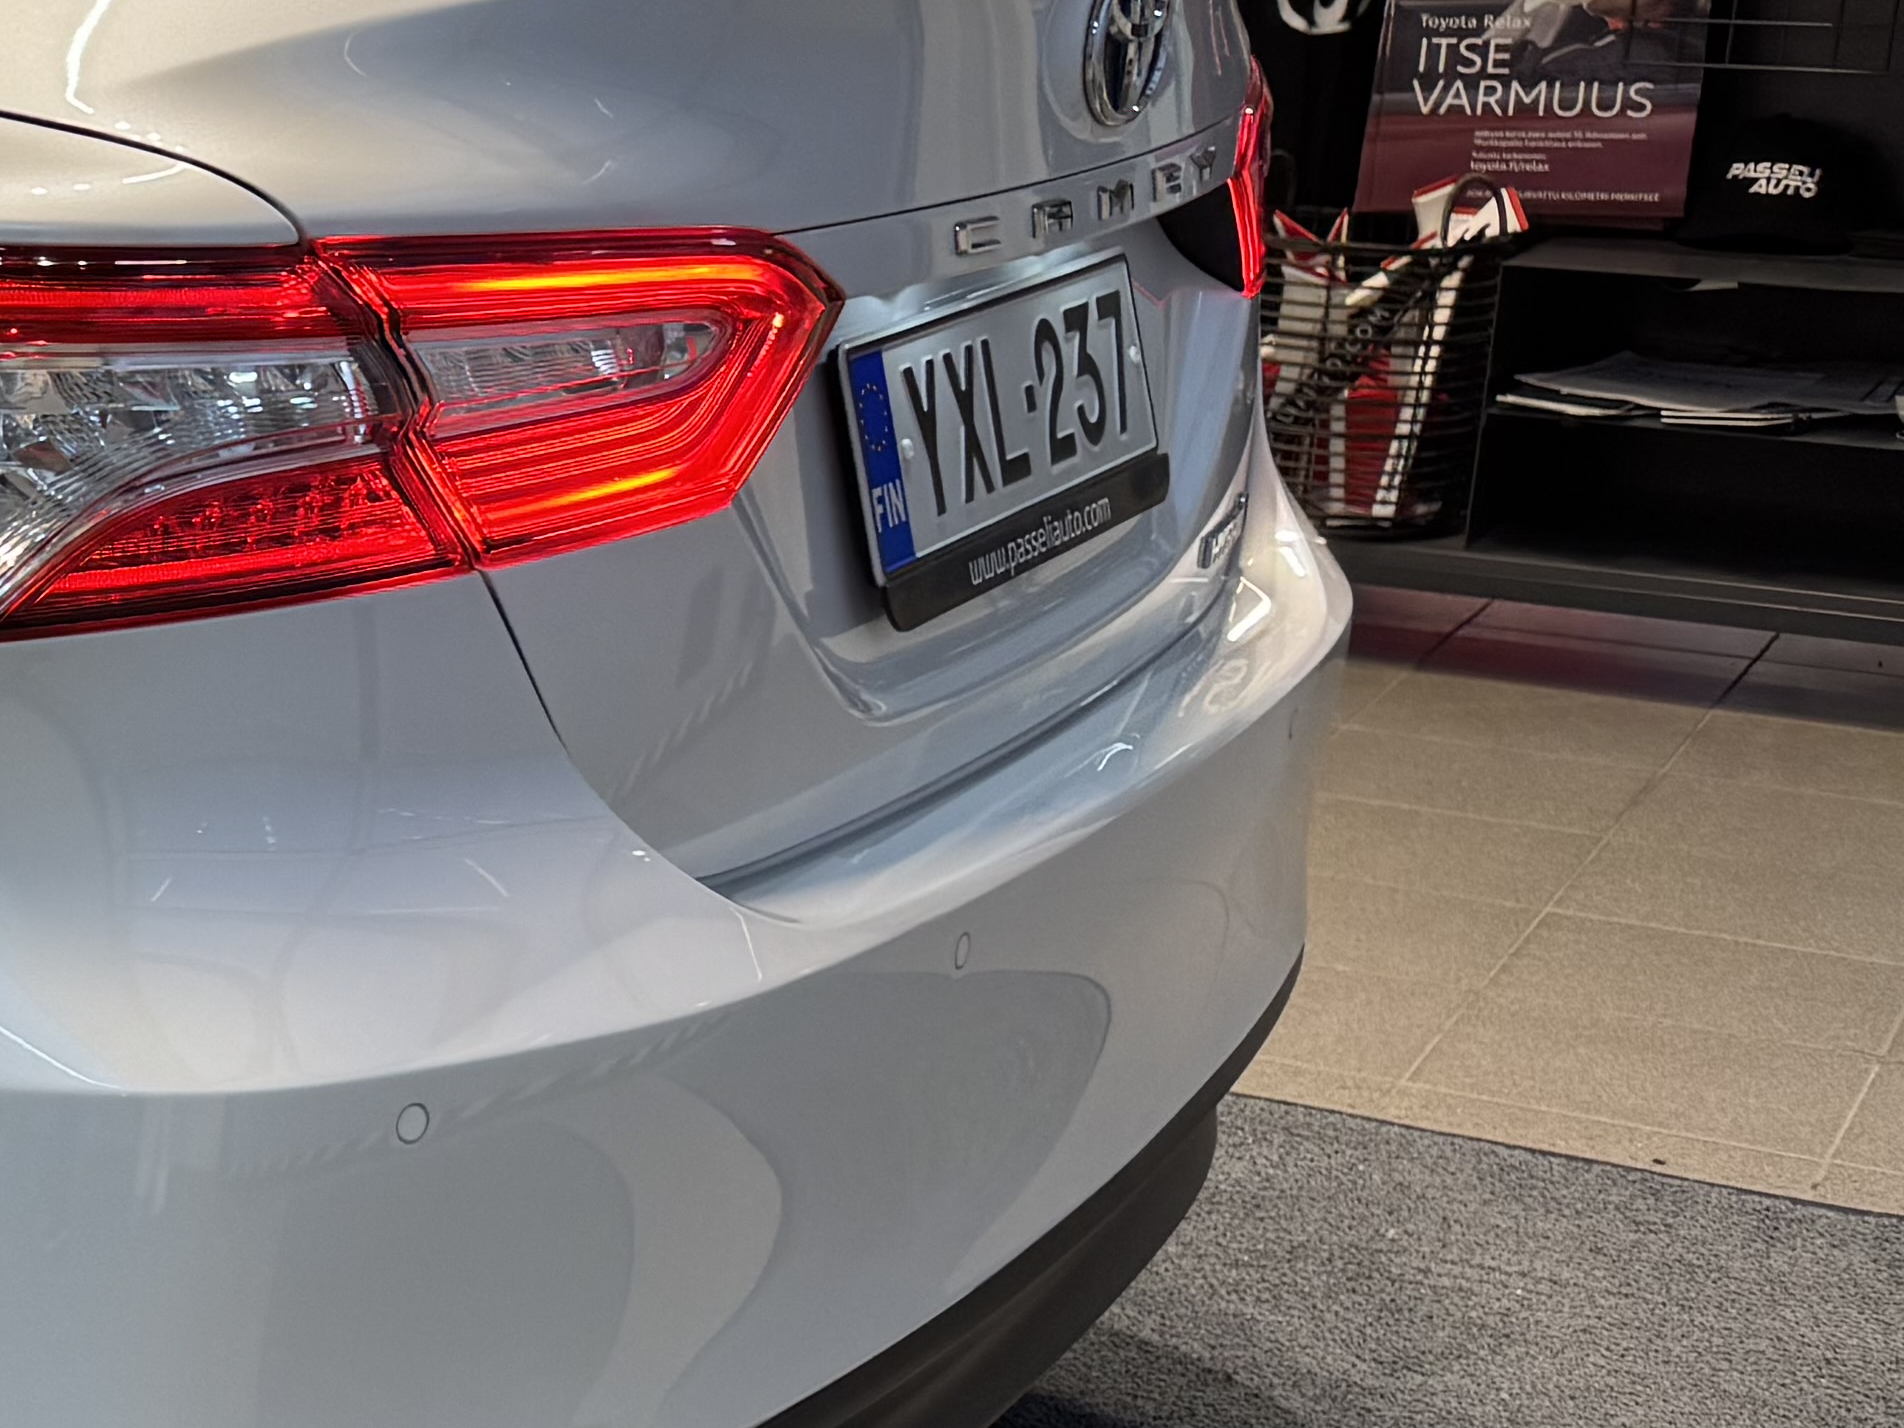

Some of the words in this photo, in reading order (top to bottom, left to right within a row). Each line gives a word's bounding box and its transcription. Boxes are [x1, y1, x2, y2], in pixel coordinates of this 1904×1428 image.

[1420, 12, 1477, 32] Toyota
[1484, 12, 1532, 30] Relax
[1418, 36, 1513, 74] ITSE
[1412, 79, 1655, 118] VARMUUS
[1747, 177, 1819, 199] AUTO
[900, 288, 1129, 517] YXL-237
[871, 479, 908, 533] FIN
[968, 497, 1112, 586] www.passeliauto.com
